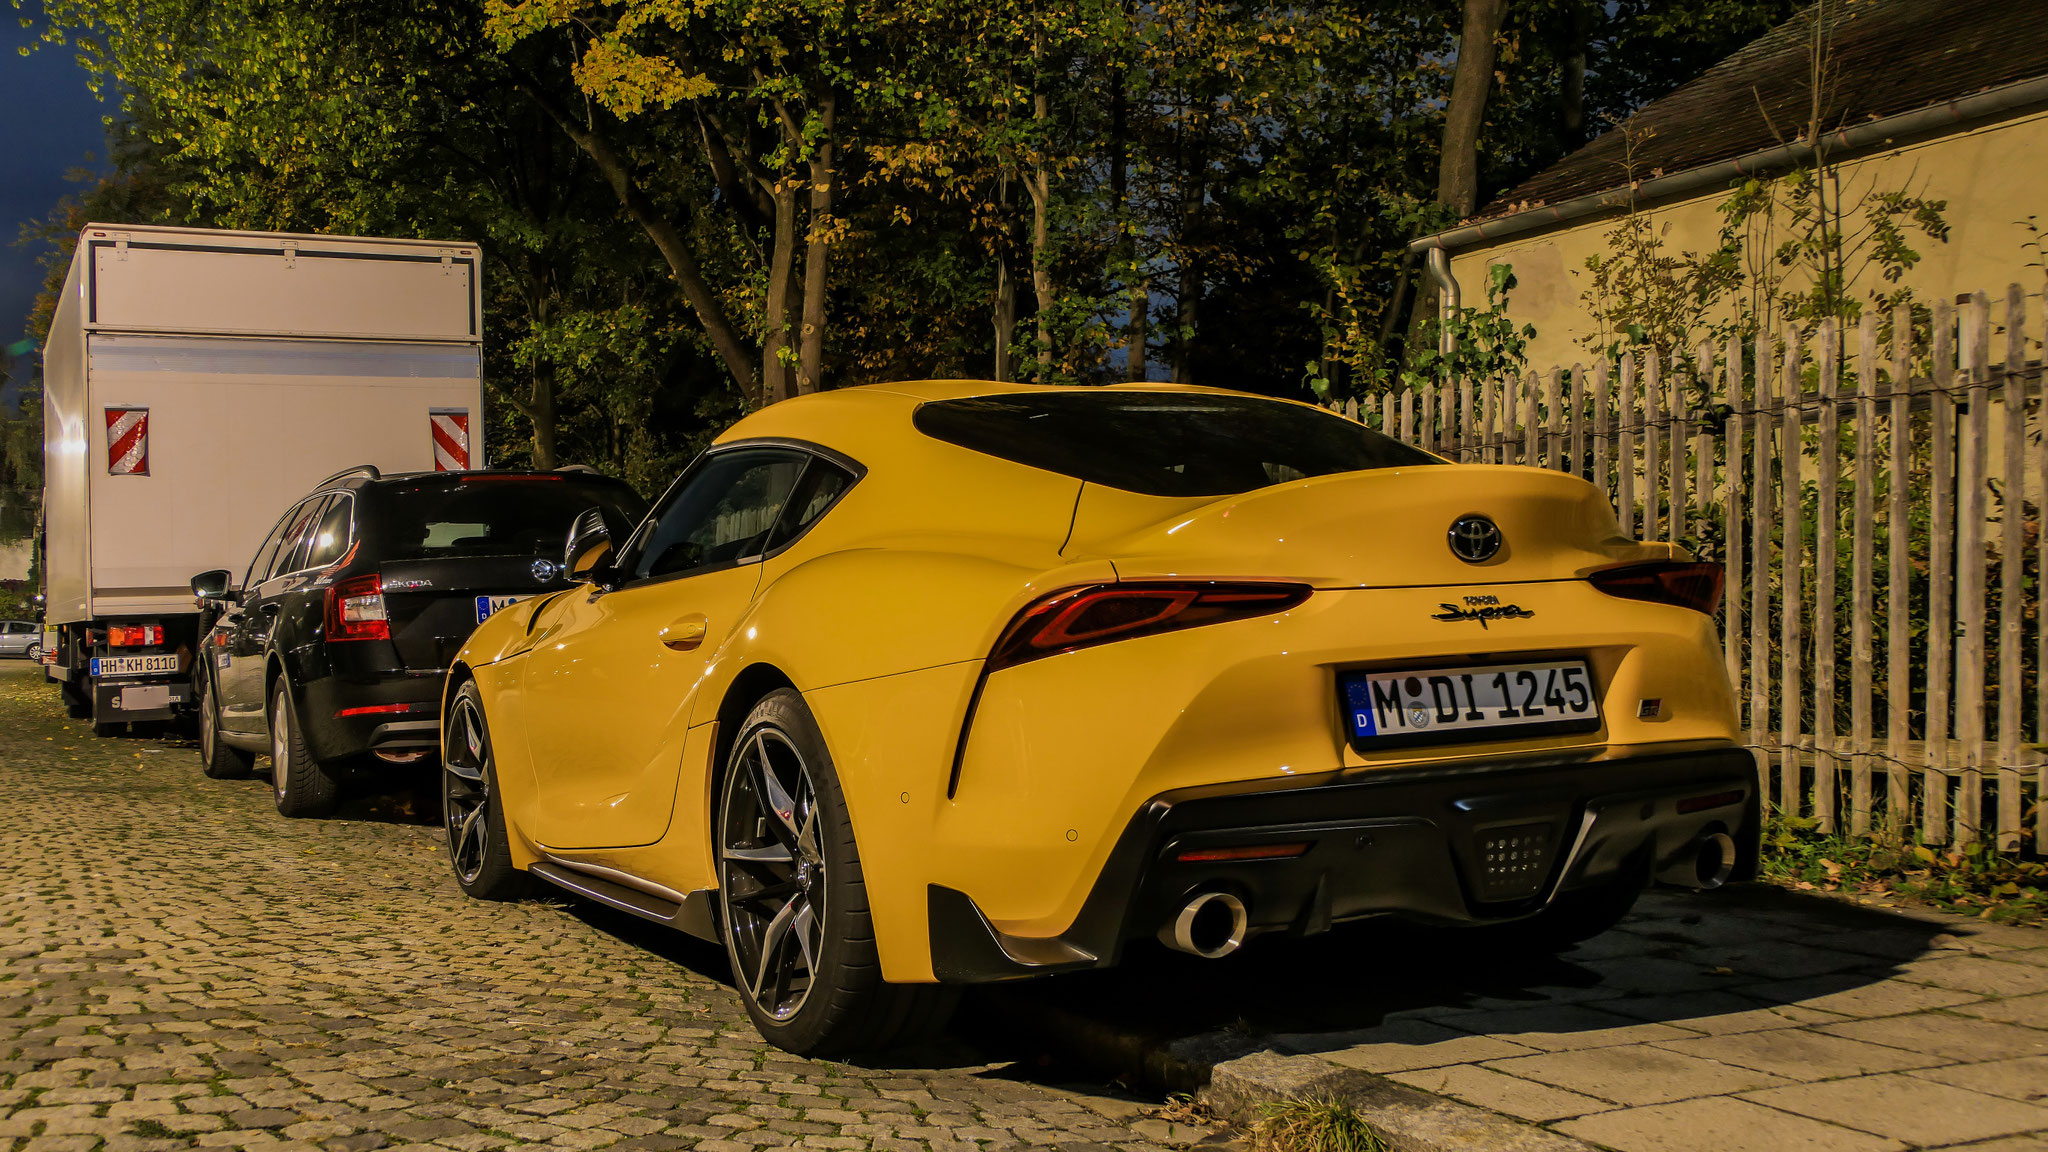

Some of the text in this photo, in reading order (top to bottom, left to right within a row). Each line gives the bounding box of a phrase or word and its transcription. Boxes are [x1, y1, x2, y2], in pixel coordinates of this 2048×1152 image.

[1430, 603, 1536, 630] Supra
[100, 659, 117, 673] HH
[126, 658, 143, 672] KH
[146, 657, 176, 671] 8110
[1356, 667, 1589, 729] D M DI 1245
